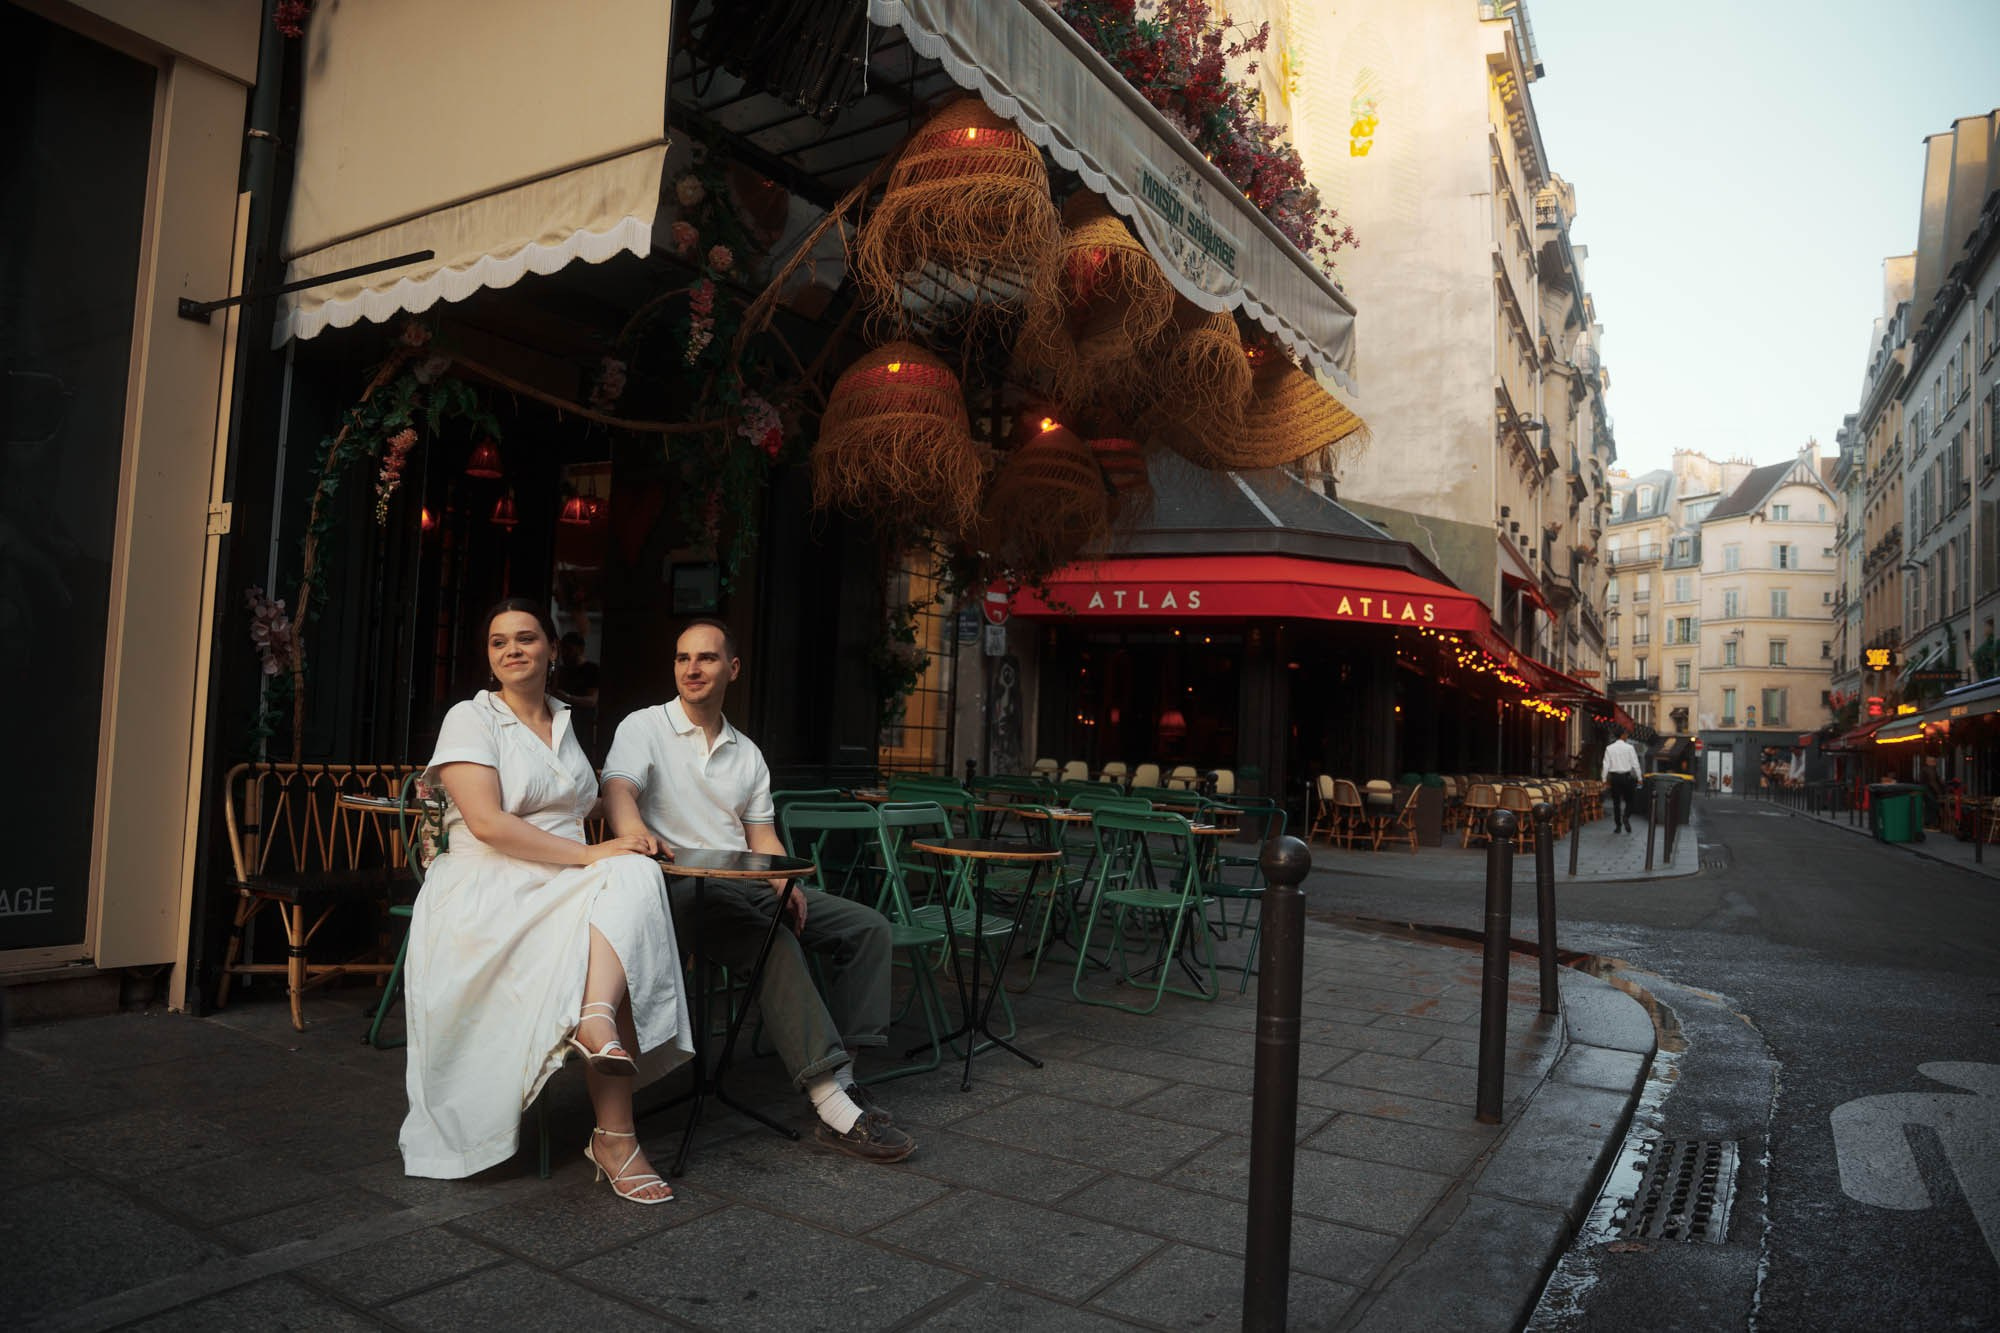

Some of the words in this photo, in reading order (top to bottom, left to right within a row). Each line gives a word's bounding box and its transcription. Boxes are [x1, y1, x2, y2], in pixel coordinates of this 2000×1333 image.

[1142, 170, 1185, 227] MAISON
[1088, 590, 1200, 609] ATLAS
[1336, 596, 1435, 622] ATLAS
[0, 886, 55, 915] AGE
